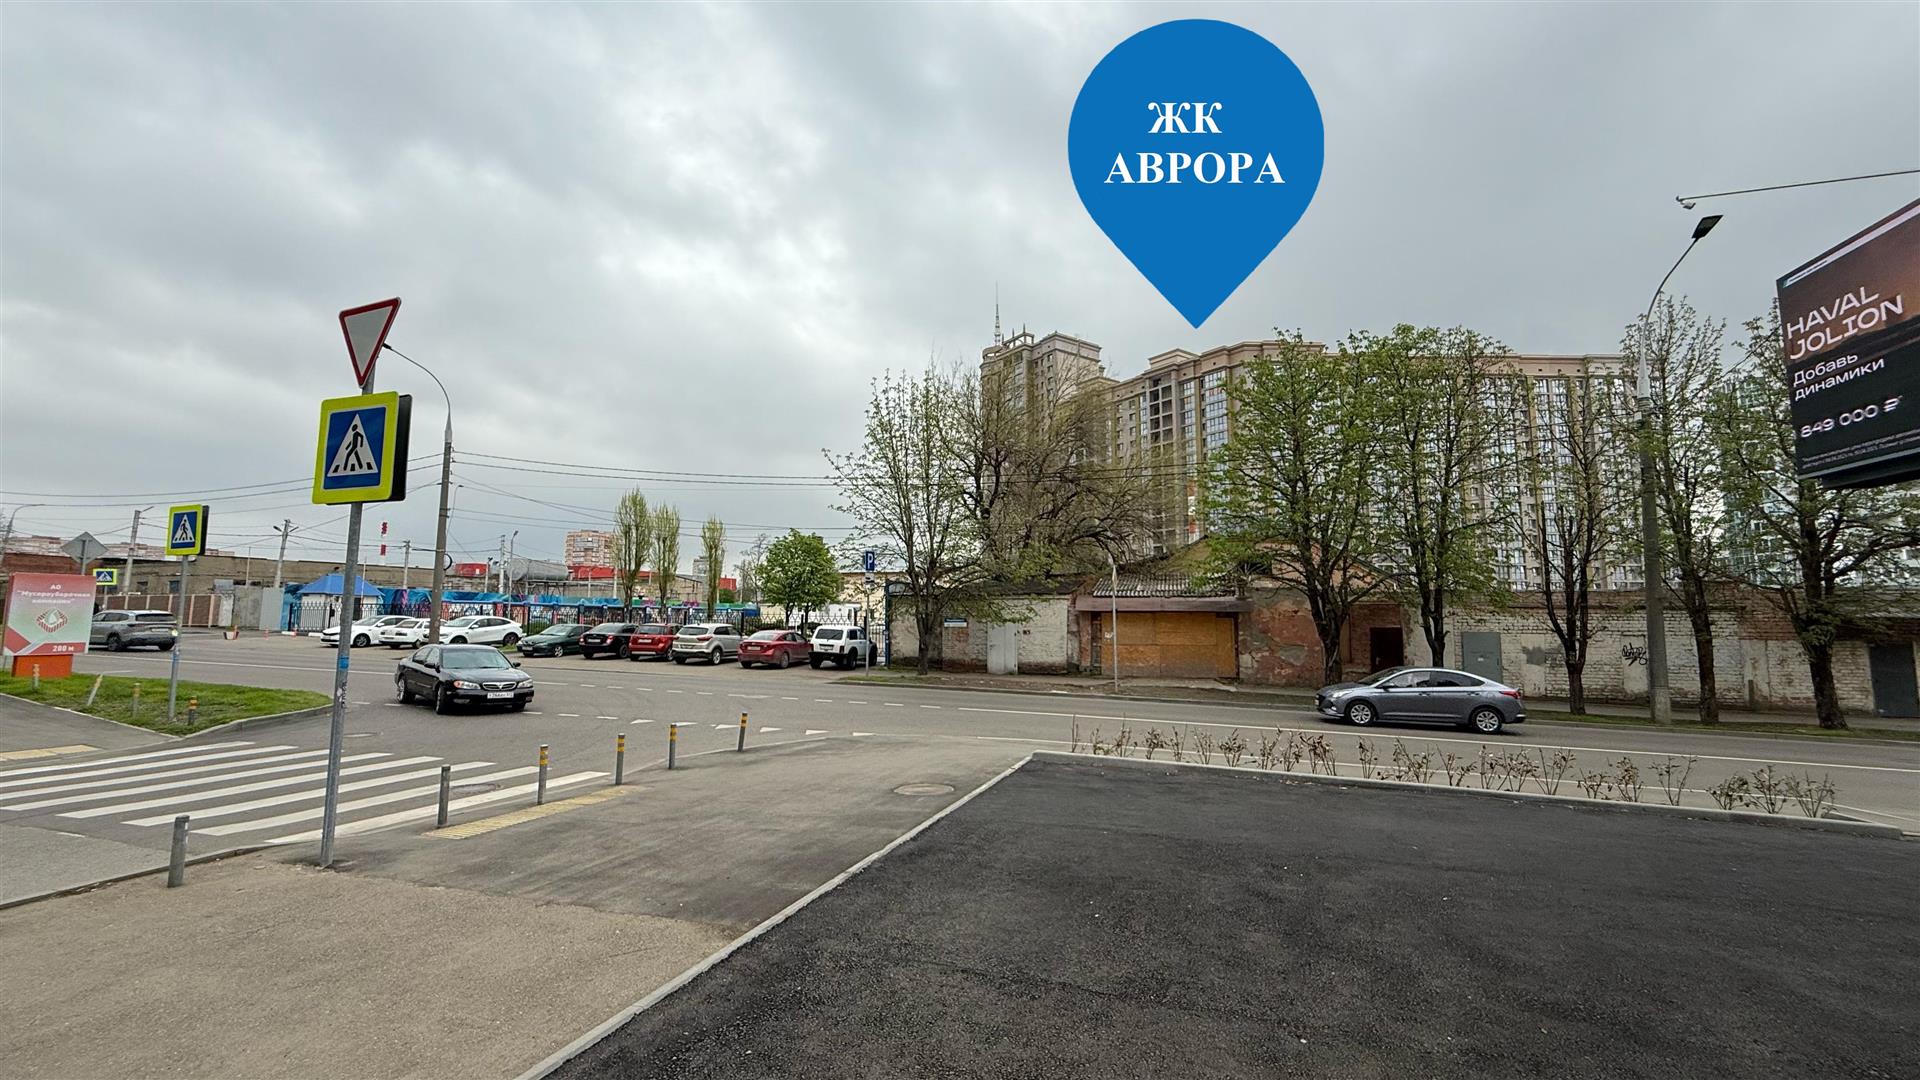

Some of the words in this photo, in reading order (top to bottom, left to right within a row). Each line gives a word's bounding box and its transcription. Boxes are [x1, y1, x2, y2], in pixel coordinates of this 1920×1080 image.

[1787, 286, 1880, 340] HAVAL
[1789, 294, 1904, 360] JOLION
[1793, 353, 1858, 387] Добавь
[1794, 357, 1885, 401] динамики
[1800, 418, 1835, 438] 849
[1839, 404, 1878, 426] 000
